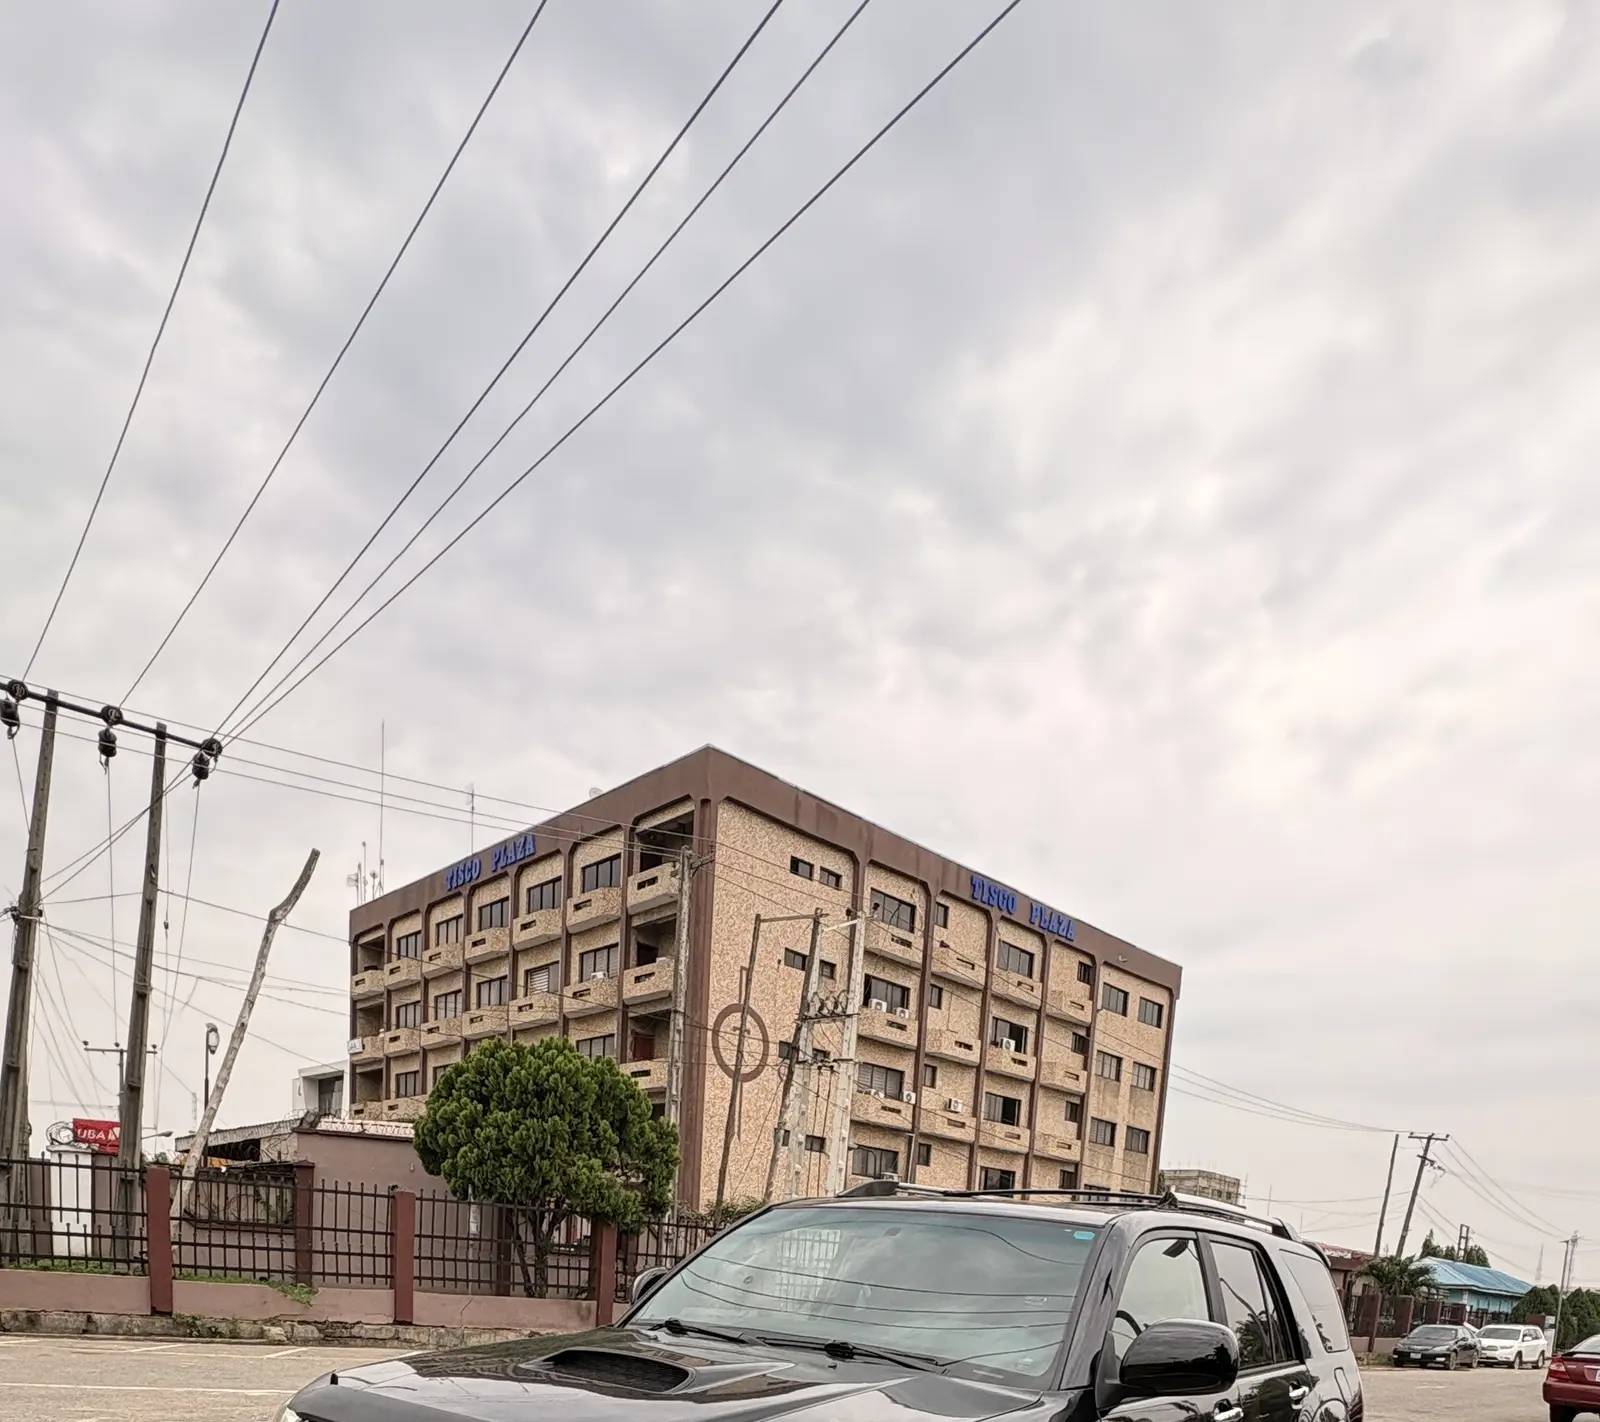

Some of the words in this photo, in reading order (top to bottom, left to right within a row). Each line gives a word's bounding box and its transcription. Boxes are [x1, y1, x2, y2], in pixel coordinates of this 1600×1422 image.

[445, 857, 482, 891] TISCO
[492, 832, 537, 873] PLAZA
[971, 875, 1018, 915] TISCO
[1029, 902, 1076, 942] PLAZA
[76, 1127, 106, 1141] UBA
